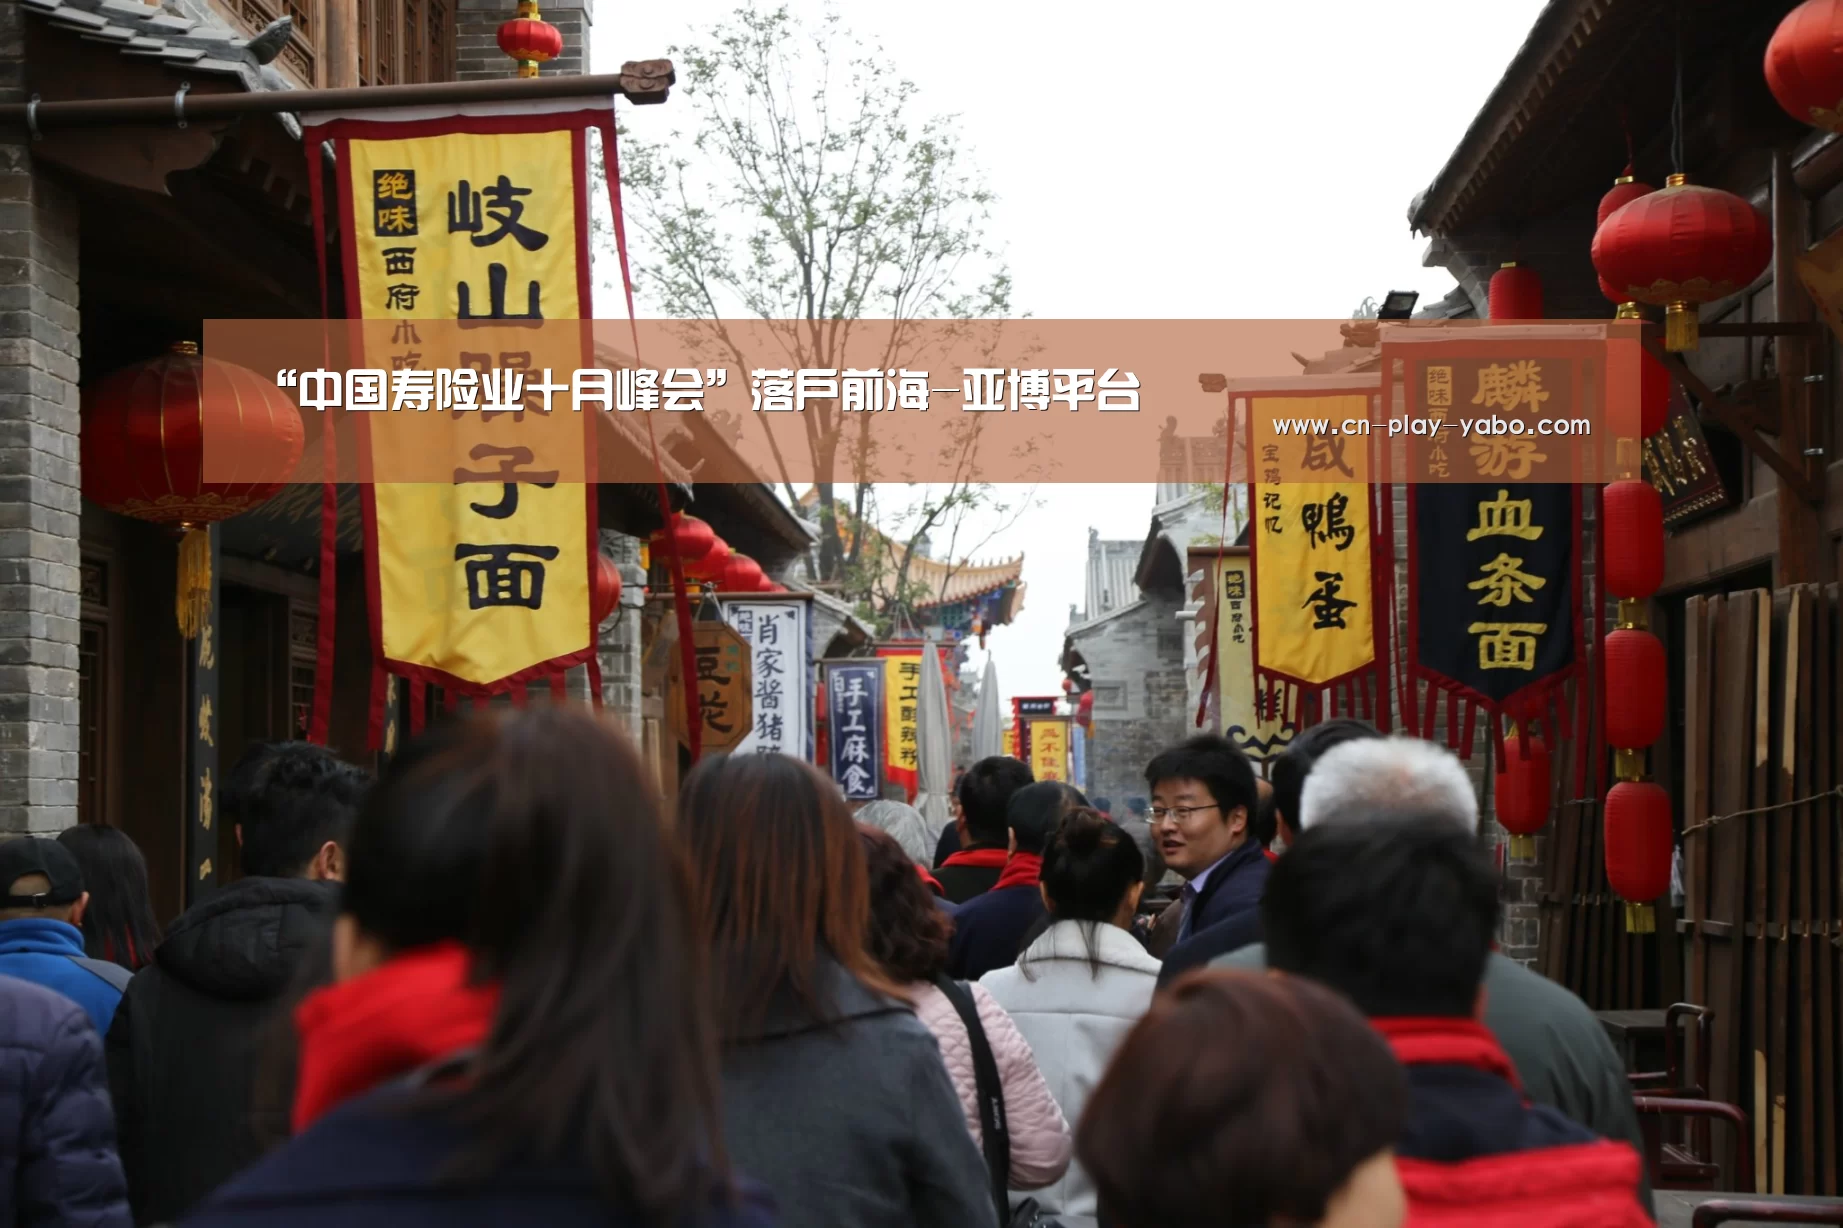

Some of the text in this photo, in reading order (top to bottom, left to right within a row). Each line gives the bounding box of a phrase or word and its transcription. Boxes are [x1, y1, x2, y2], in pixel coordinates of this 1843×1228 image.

[376, 171, 415, 234] 绝味
[1427, 366, 1452, 405] 绝味
[1466, 360, 1549, 671] 麟游血条面
[841, 677, 871, 795] 手工麻食
